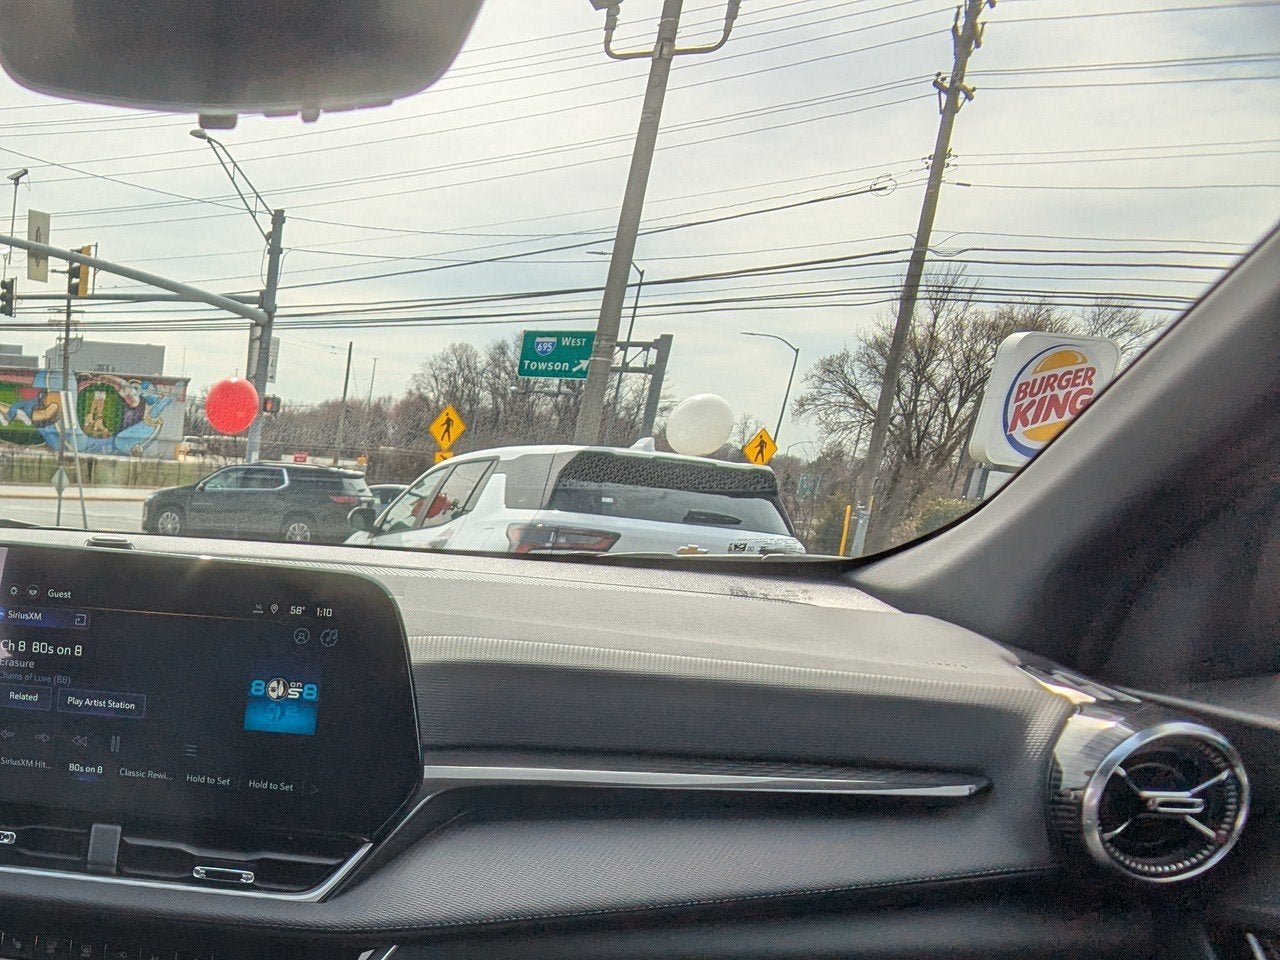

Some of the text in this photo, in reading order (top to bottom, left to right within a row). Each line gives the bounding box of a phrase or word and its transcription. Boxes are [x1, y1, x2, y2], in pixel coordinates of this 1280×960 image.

[537, 342, 553, 352] 695
[1013, 366, 1097, 405] BURGER
[1008, 387, 1095, 433] KING
[48, 588, 72, 599] Guest
[8, 610, 42, 620] SiriusXM
[290, 606, 306, 615] 58°
[316, 608, 333, 617] 1:10
[0, 640, 83, 656] Ch 8 80s on 8
[0, 658, 35, 668] Erasure
[24, 672, 33, 681] of
[9, 692, 38, 702] Related
[67, 696, 136, 710] Play Artist Station
[0, 756, 34, 768] SiriusXM
[69, 763, 84, 772] 80s
[97, 766, 103, 774] 8
[120, 768, 146, 778] Classic
[186, 774, 230, 786] Hold to Set
[248, 780, 294, 792] Hold to Set
